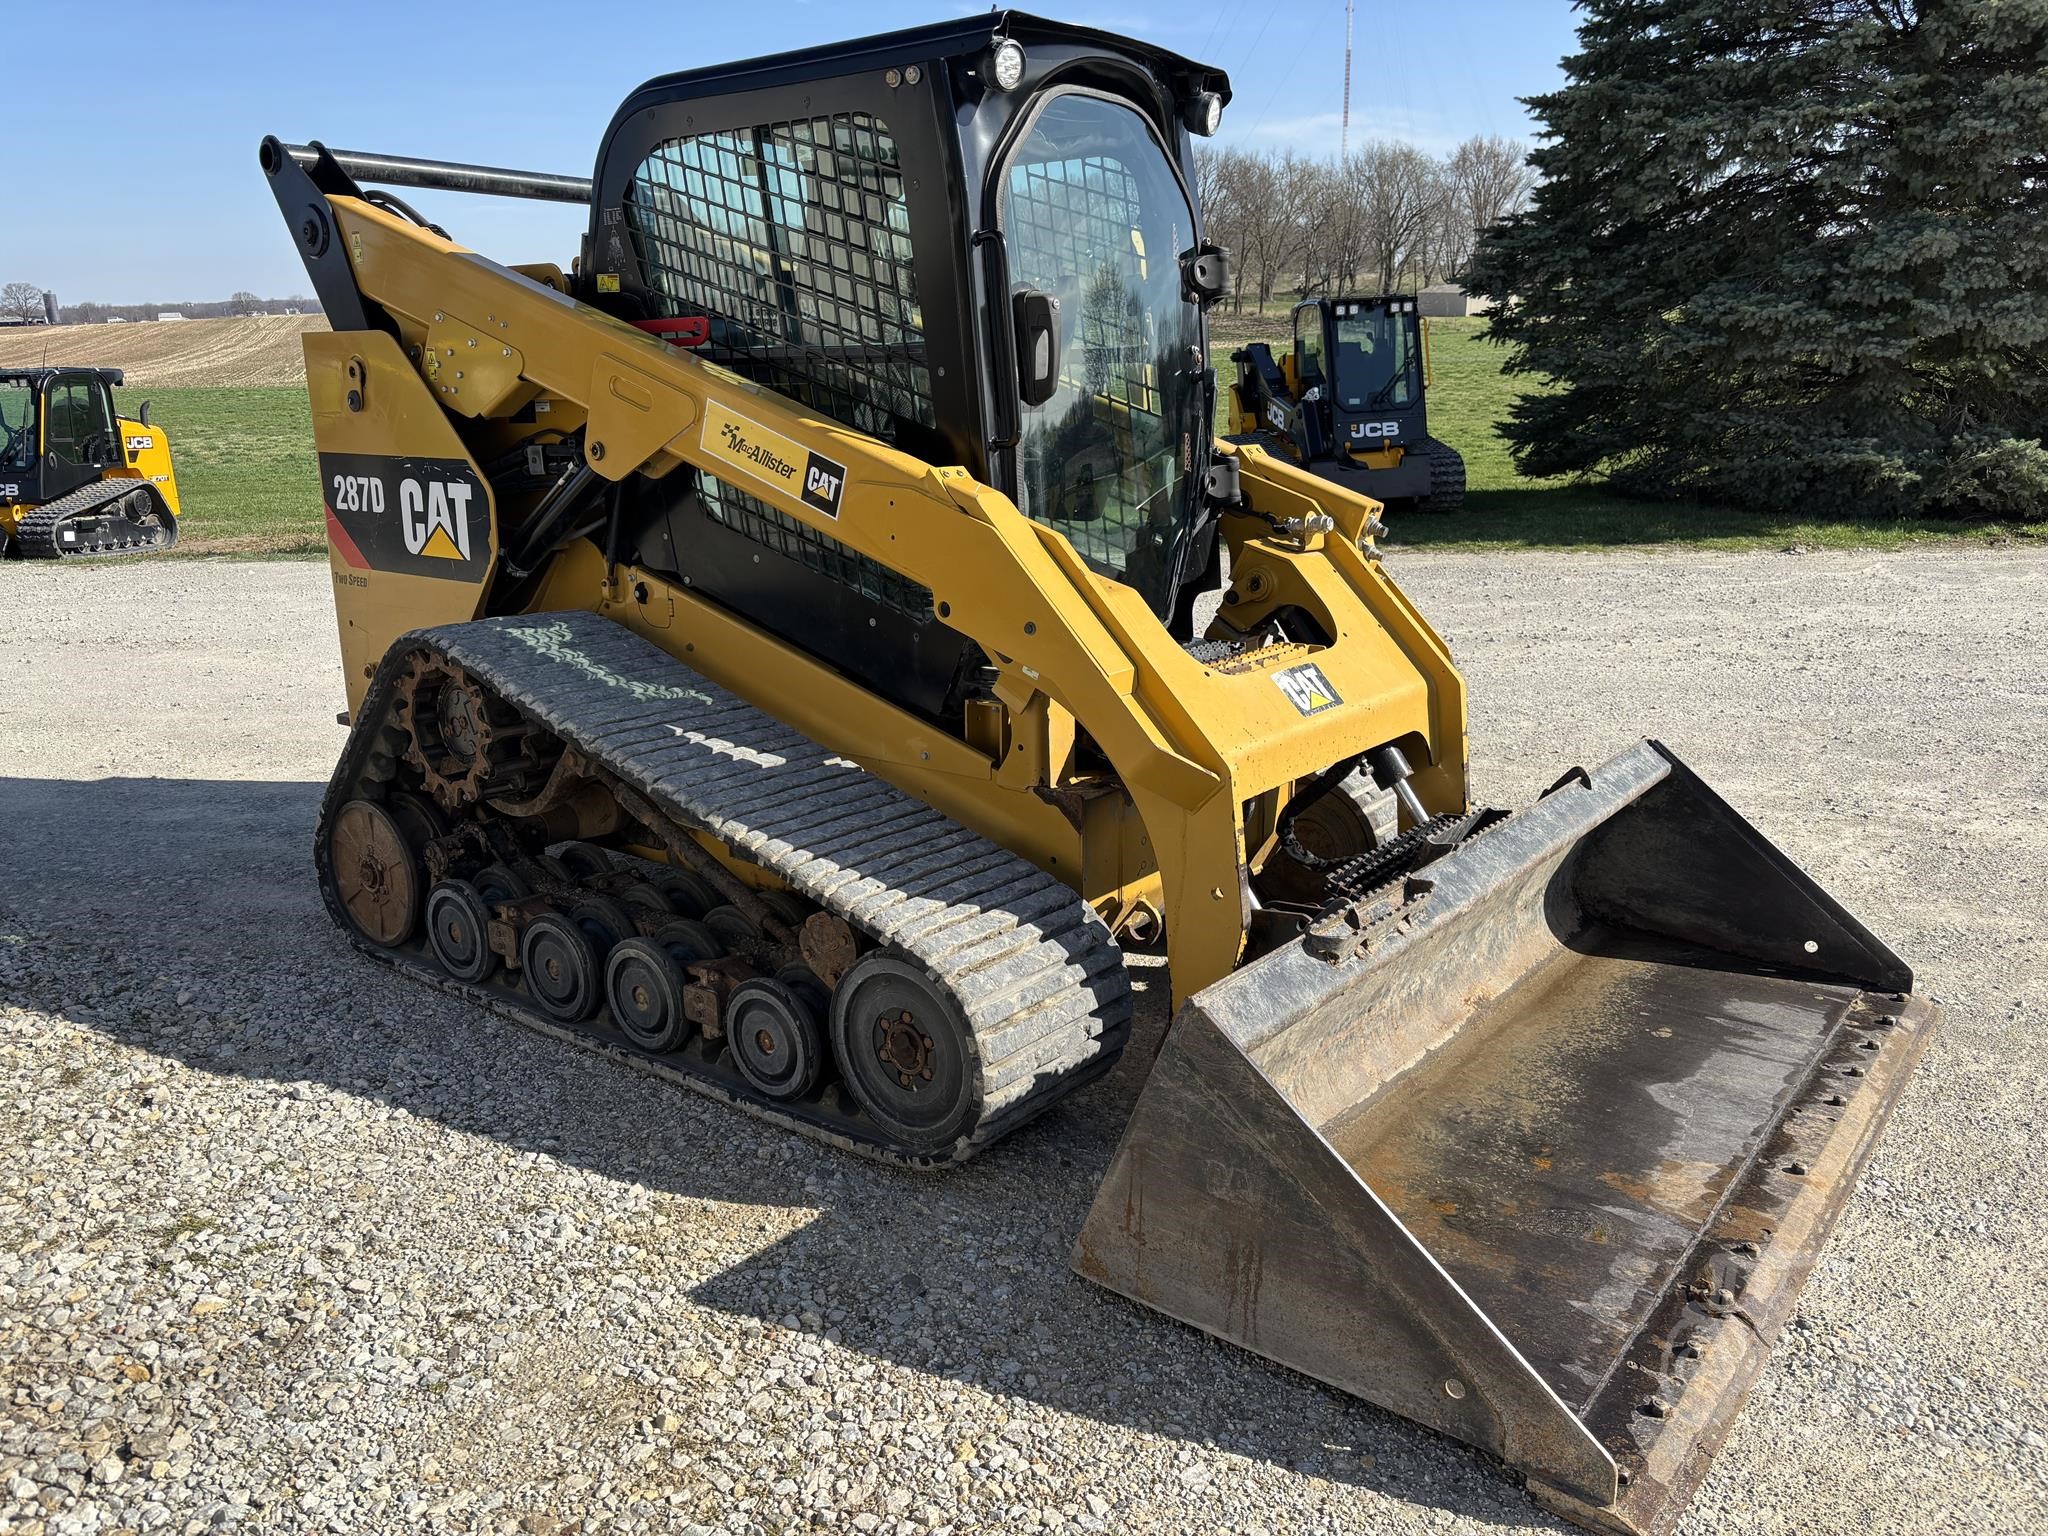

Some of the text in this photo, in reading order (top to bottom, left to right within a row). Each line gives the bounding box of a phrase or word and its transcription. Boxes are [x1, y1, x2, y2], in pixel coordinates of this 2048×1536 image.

[1267, 401, 1285, 430] JCB
[1351, 421, 1400, 438] JCB
[126, 436, 153, 449] JCB
[727, 433, 797, 480] MacAllister
[807, 466, 840, 502] CAT
[333, 474, 472, 561] 287D CAT
[1279, 667, 1335, 711] CAT
